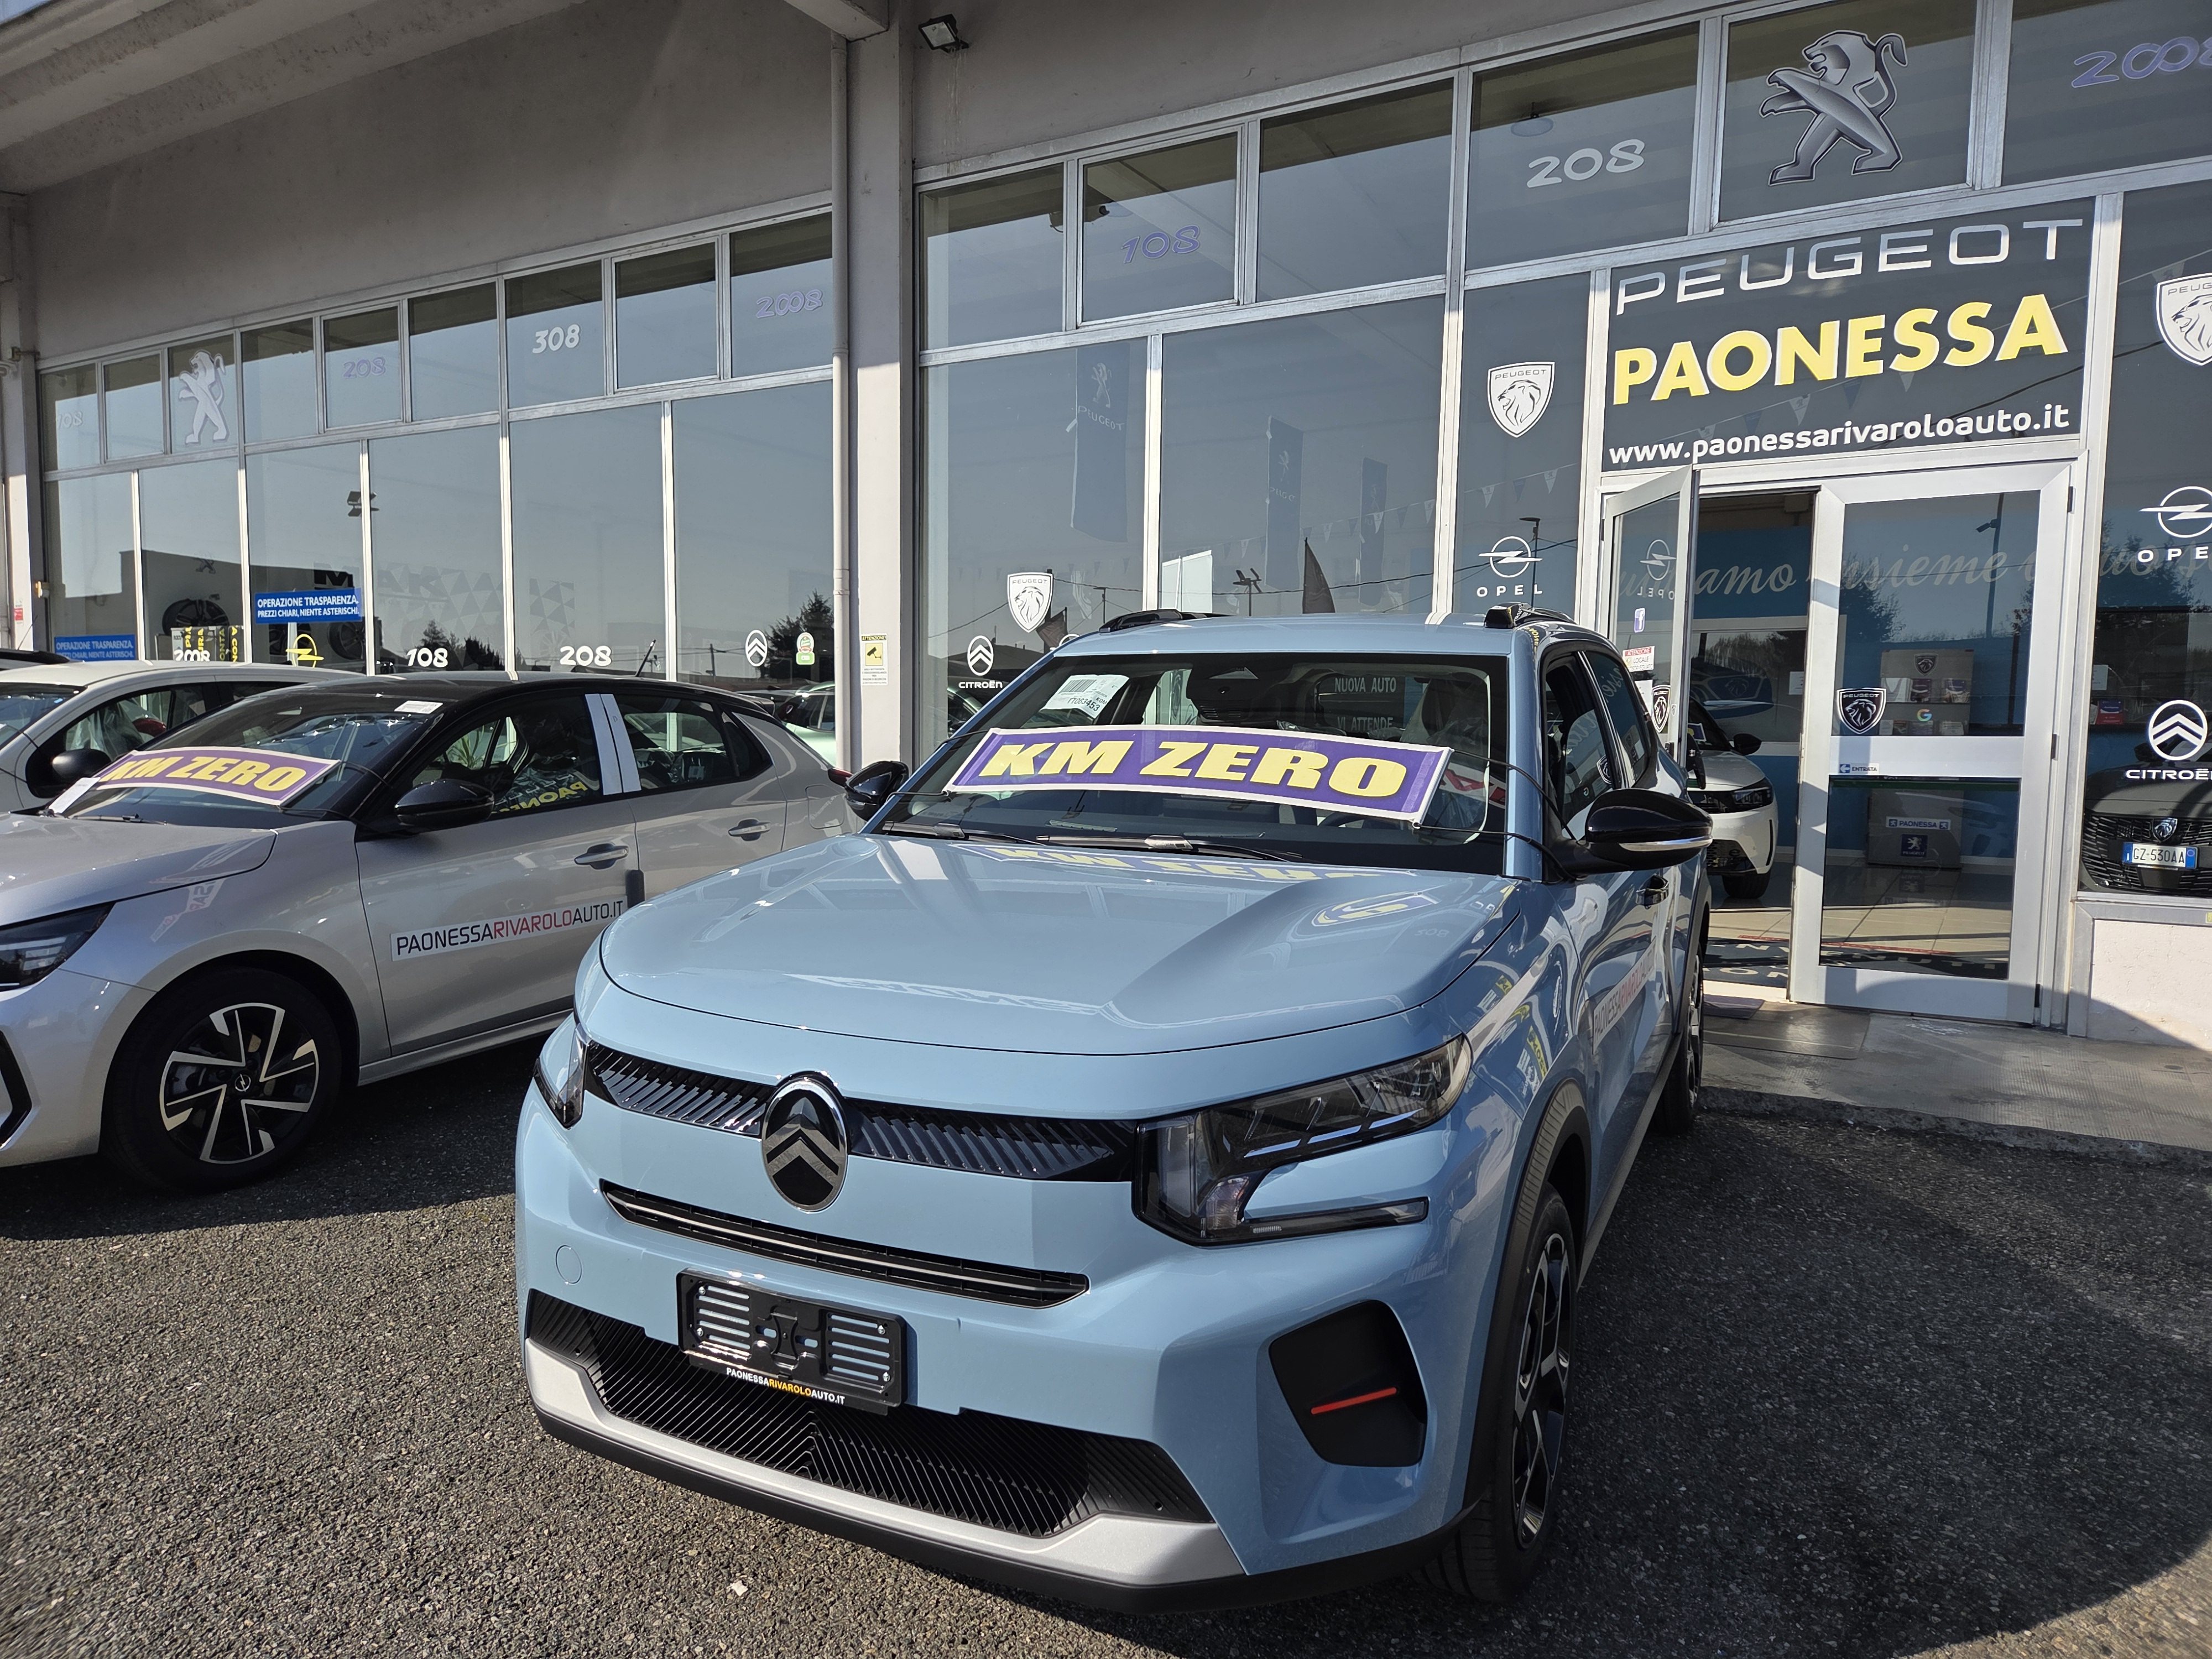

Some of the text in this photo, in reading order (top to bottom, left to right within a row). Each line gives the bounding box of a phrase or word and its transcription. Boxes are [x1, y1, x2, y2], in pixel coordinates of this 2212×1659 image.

[1526, 138, 1645, 189] 208
[1121, 224, 1201, 264] 108
[1616, 218, 2083, 316] PEUGEOT
[755, 289, 823, 319] 2008
[531, 324, 581, 354] 308
[1613, 293, 2068, 406] PAONESSA
[343, 357, 386, 379] 208
[1495, 368, 1547, 380] PEUGEOT
[1609, 403, 2069, 465] www.paonessarivaroloauto.it
[258, 594, 359, 608] OPERAZIONE TRASPARENZA.
[1476, 583, 1543, 597] OPEL
[300, 608, 322, 617] NIENTE
[56, 641, 91, 651] OPERAZIONE
[406, 647, 448, 668] 108
[560, 645, 612, 667] 208
[1334, 676, 1397, 692] NUOVA AUTO
[100, 756, 306, 792] KM ZERO
[978, 740, 1407, 799] KM ZERO
[2126, 768, 2212, 780] CITROË
[1898, 820, 1937, 828] PAONESSA
[397, 900, 624, 956] PAONESSARIVAROLOAUTO.IT
[726, 1367, 845, 1405] PAONESSARIVAROLOAUTO.IT
